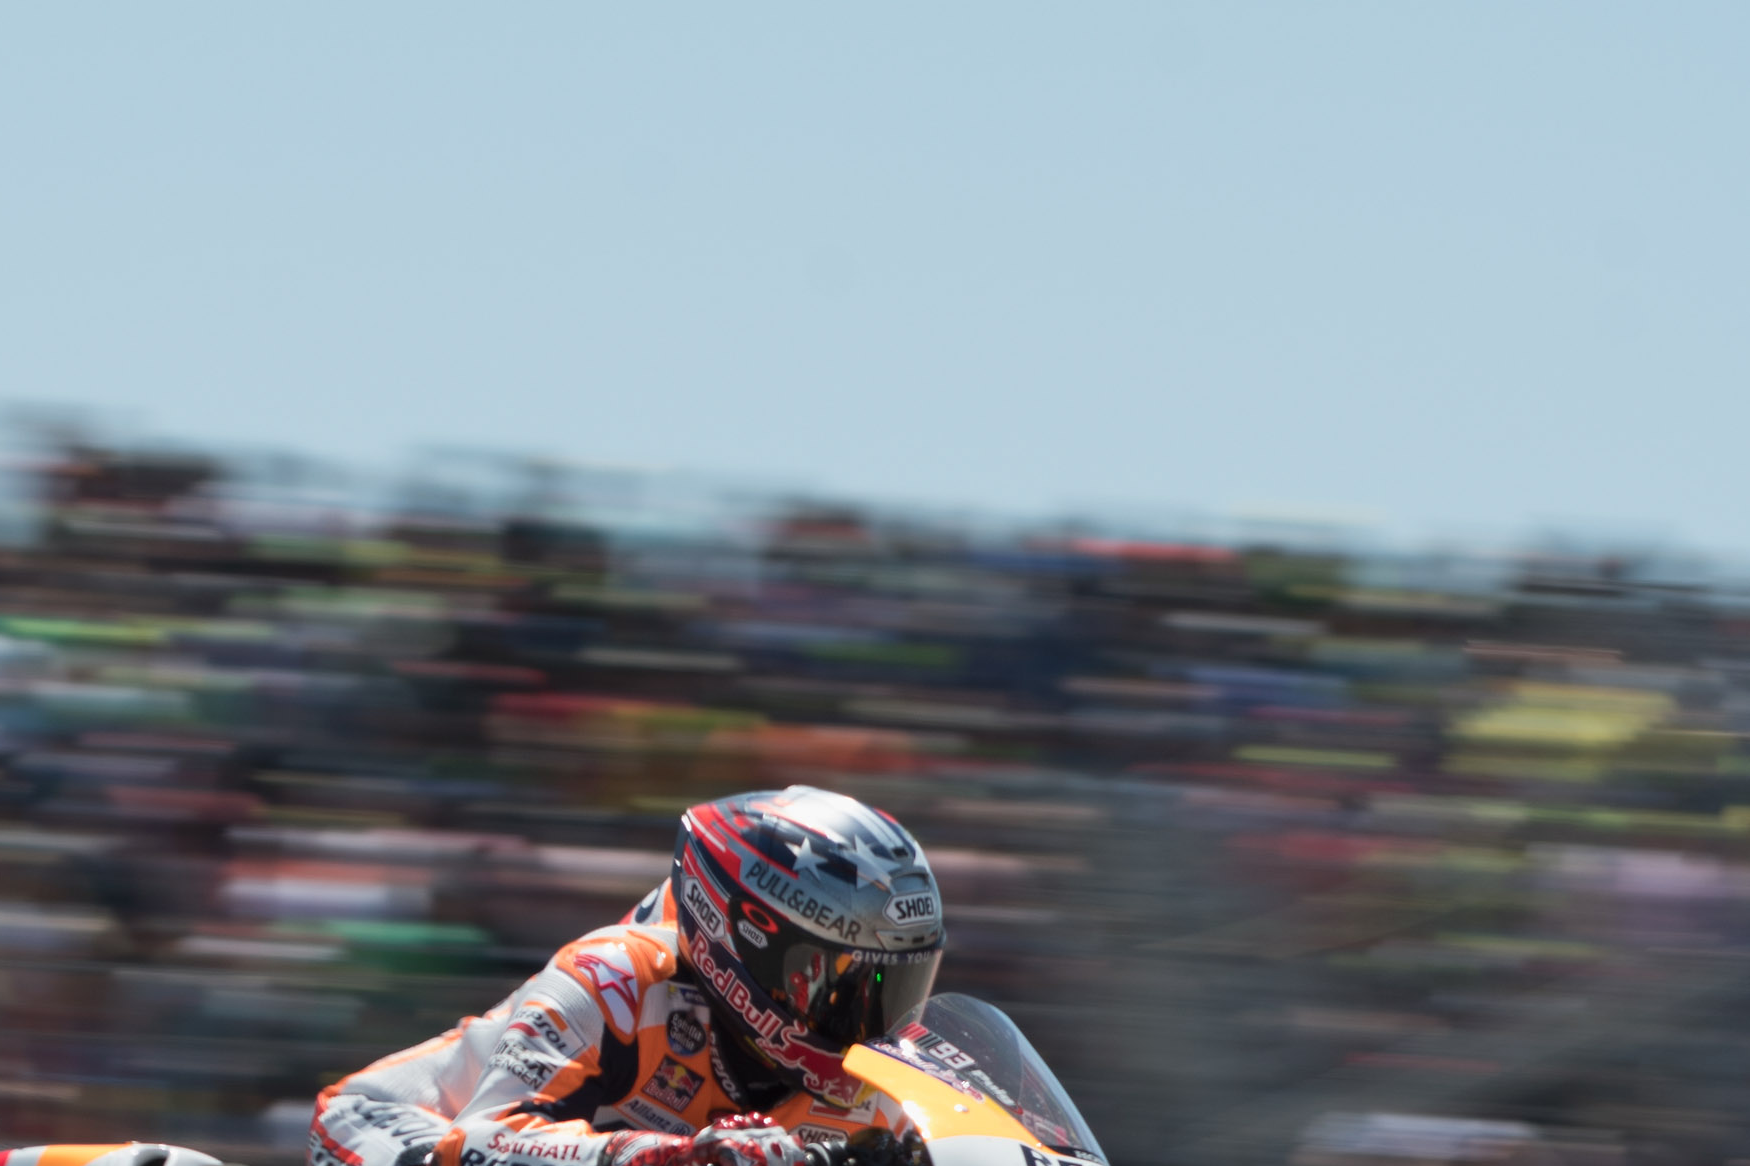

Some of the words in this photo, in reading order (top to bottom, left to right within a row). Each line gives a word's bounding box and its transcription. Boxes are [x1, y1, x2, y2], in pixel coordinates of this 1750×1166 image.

[686, 884, 721, 936] SHOEI
[746, 861, 862, 942] PULL&BEAR
[895, 896, 934, 920] SHOEI
[740, 922, 764, 945] SHOEI
[852, 950, 898, 966] GIVES
[929, 1041, 976, 1070] 93
[628, 1100, 671, 1130] Allianz
